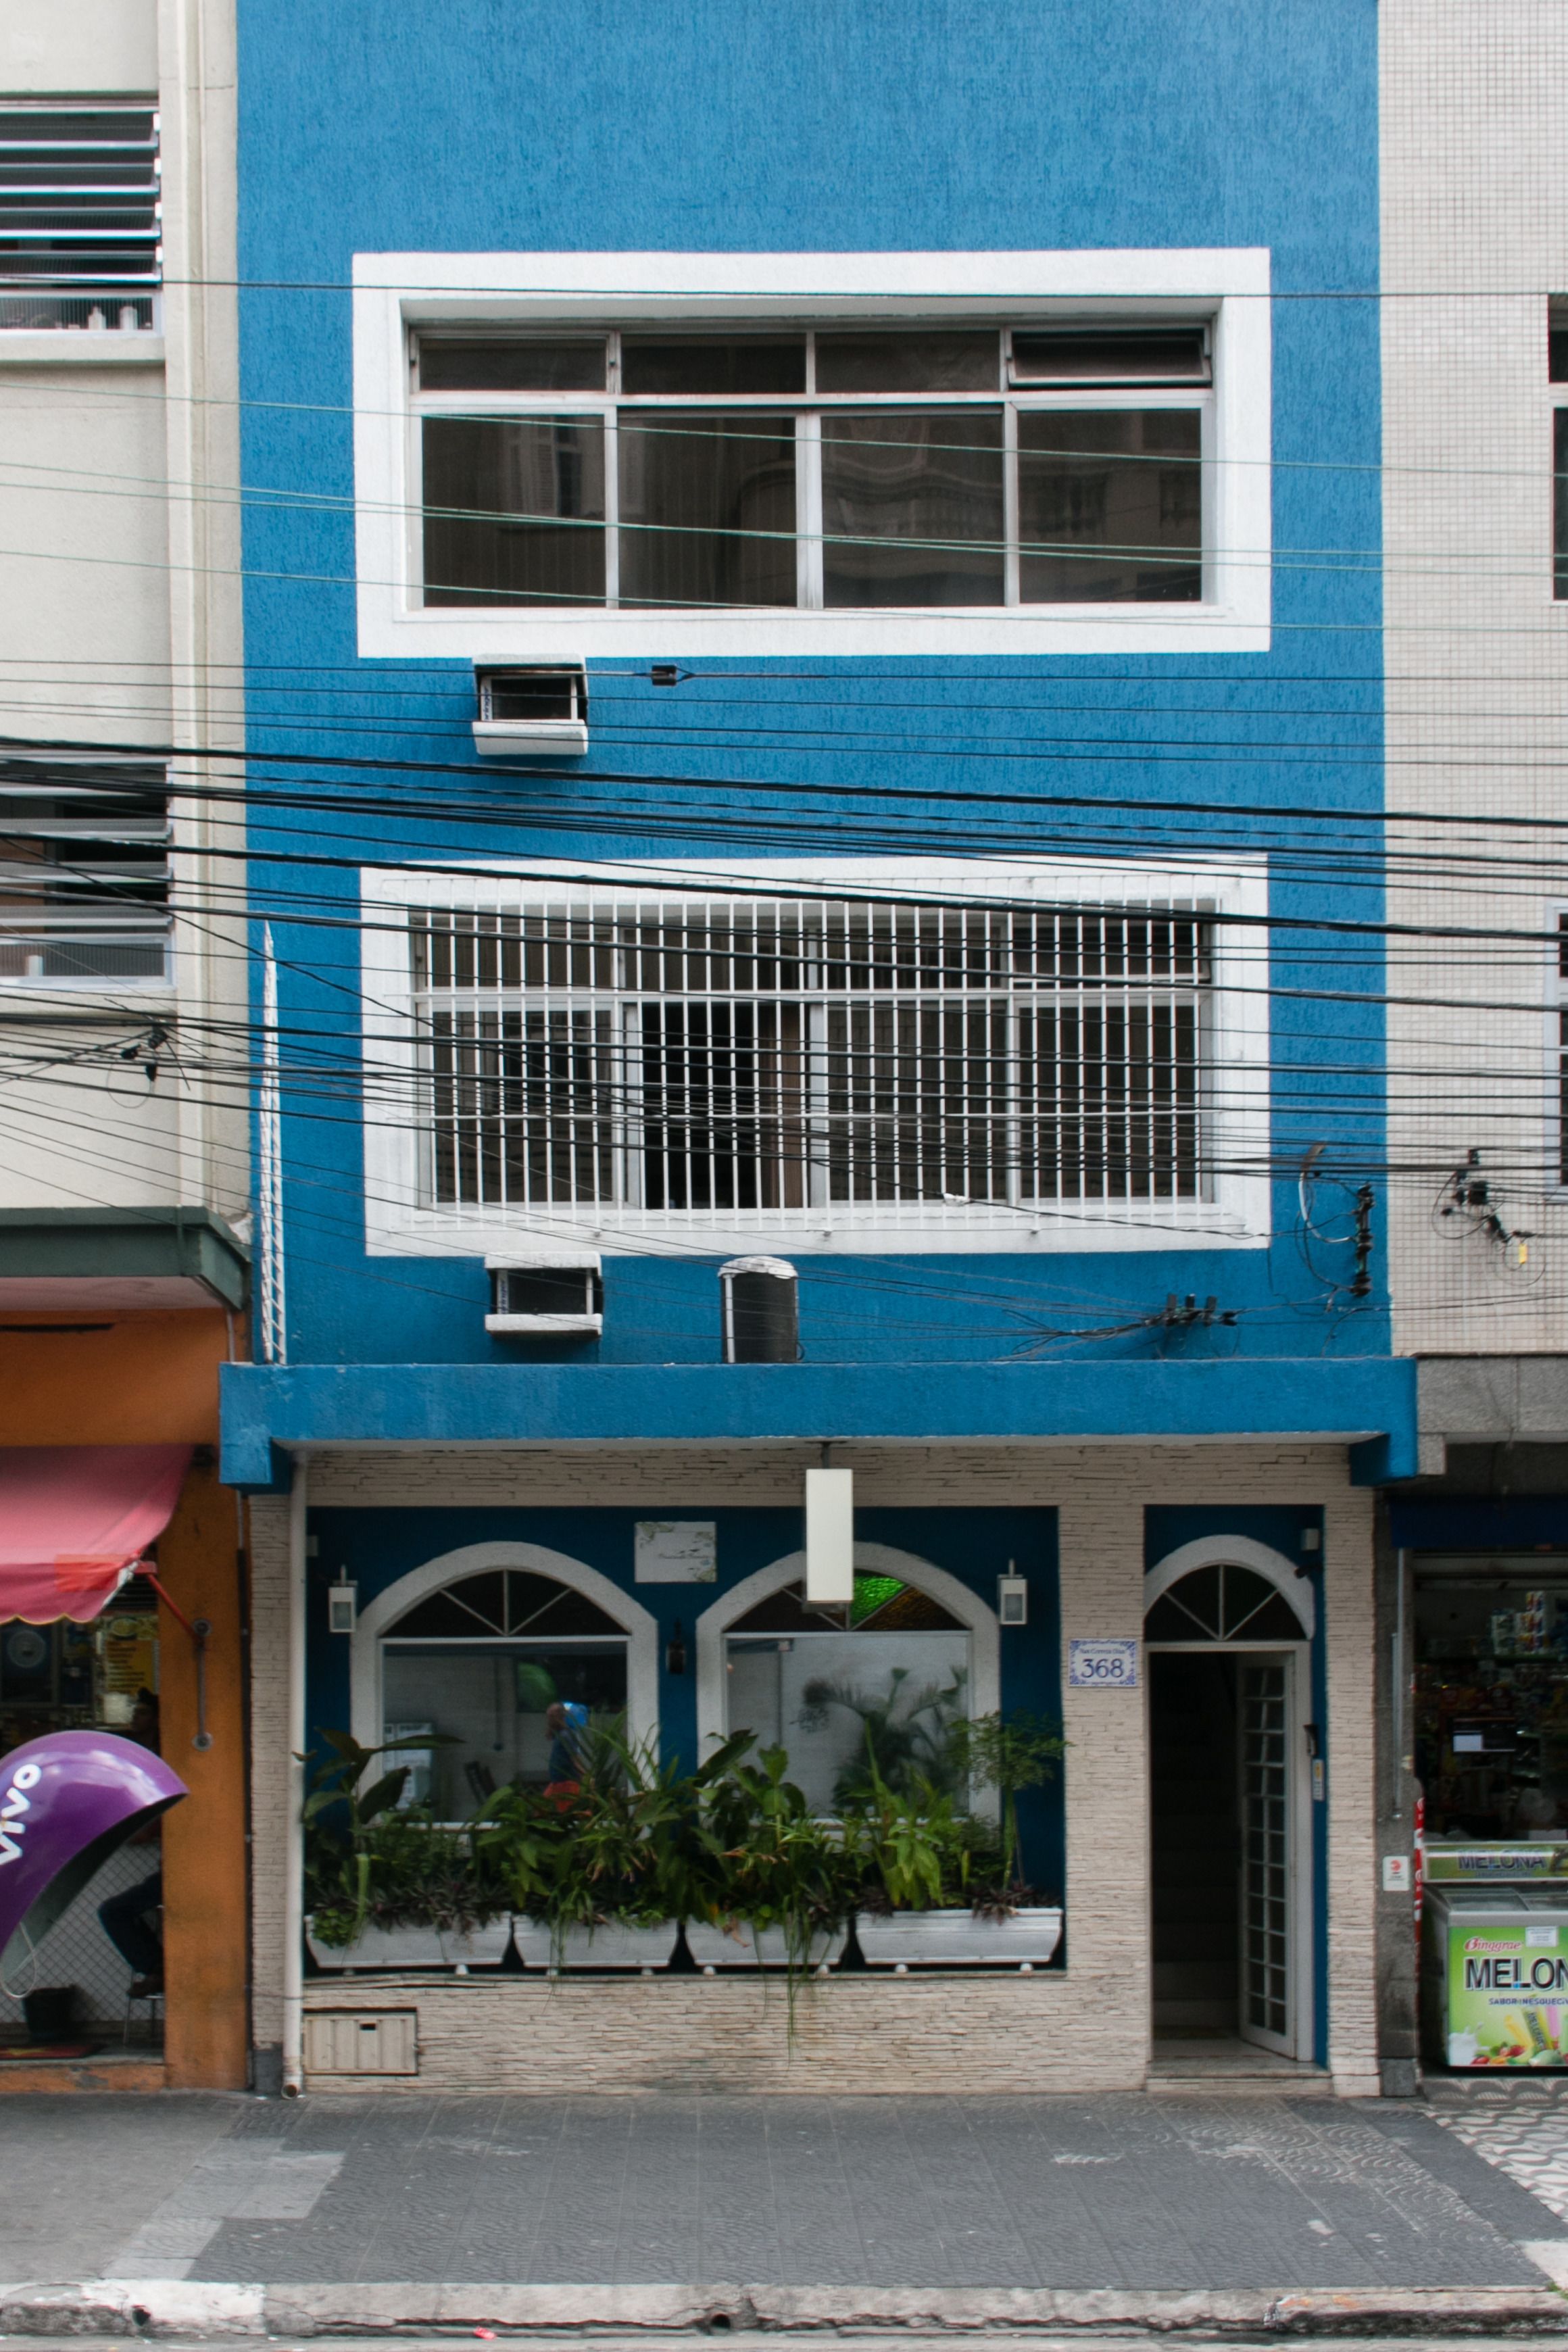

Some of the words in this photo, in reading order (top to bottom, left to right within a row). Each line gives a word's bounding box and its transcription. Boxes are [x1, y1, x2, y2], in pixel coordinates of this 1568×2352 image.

[1081, 1658, 1123, 1678] 368
[0, 1763, 41, 1865] vivo
[1458, 1848, 1548, 1870] MELONA
[1464, 1936, 1521, 1953] Binggrae
